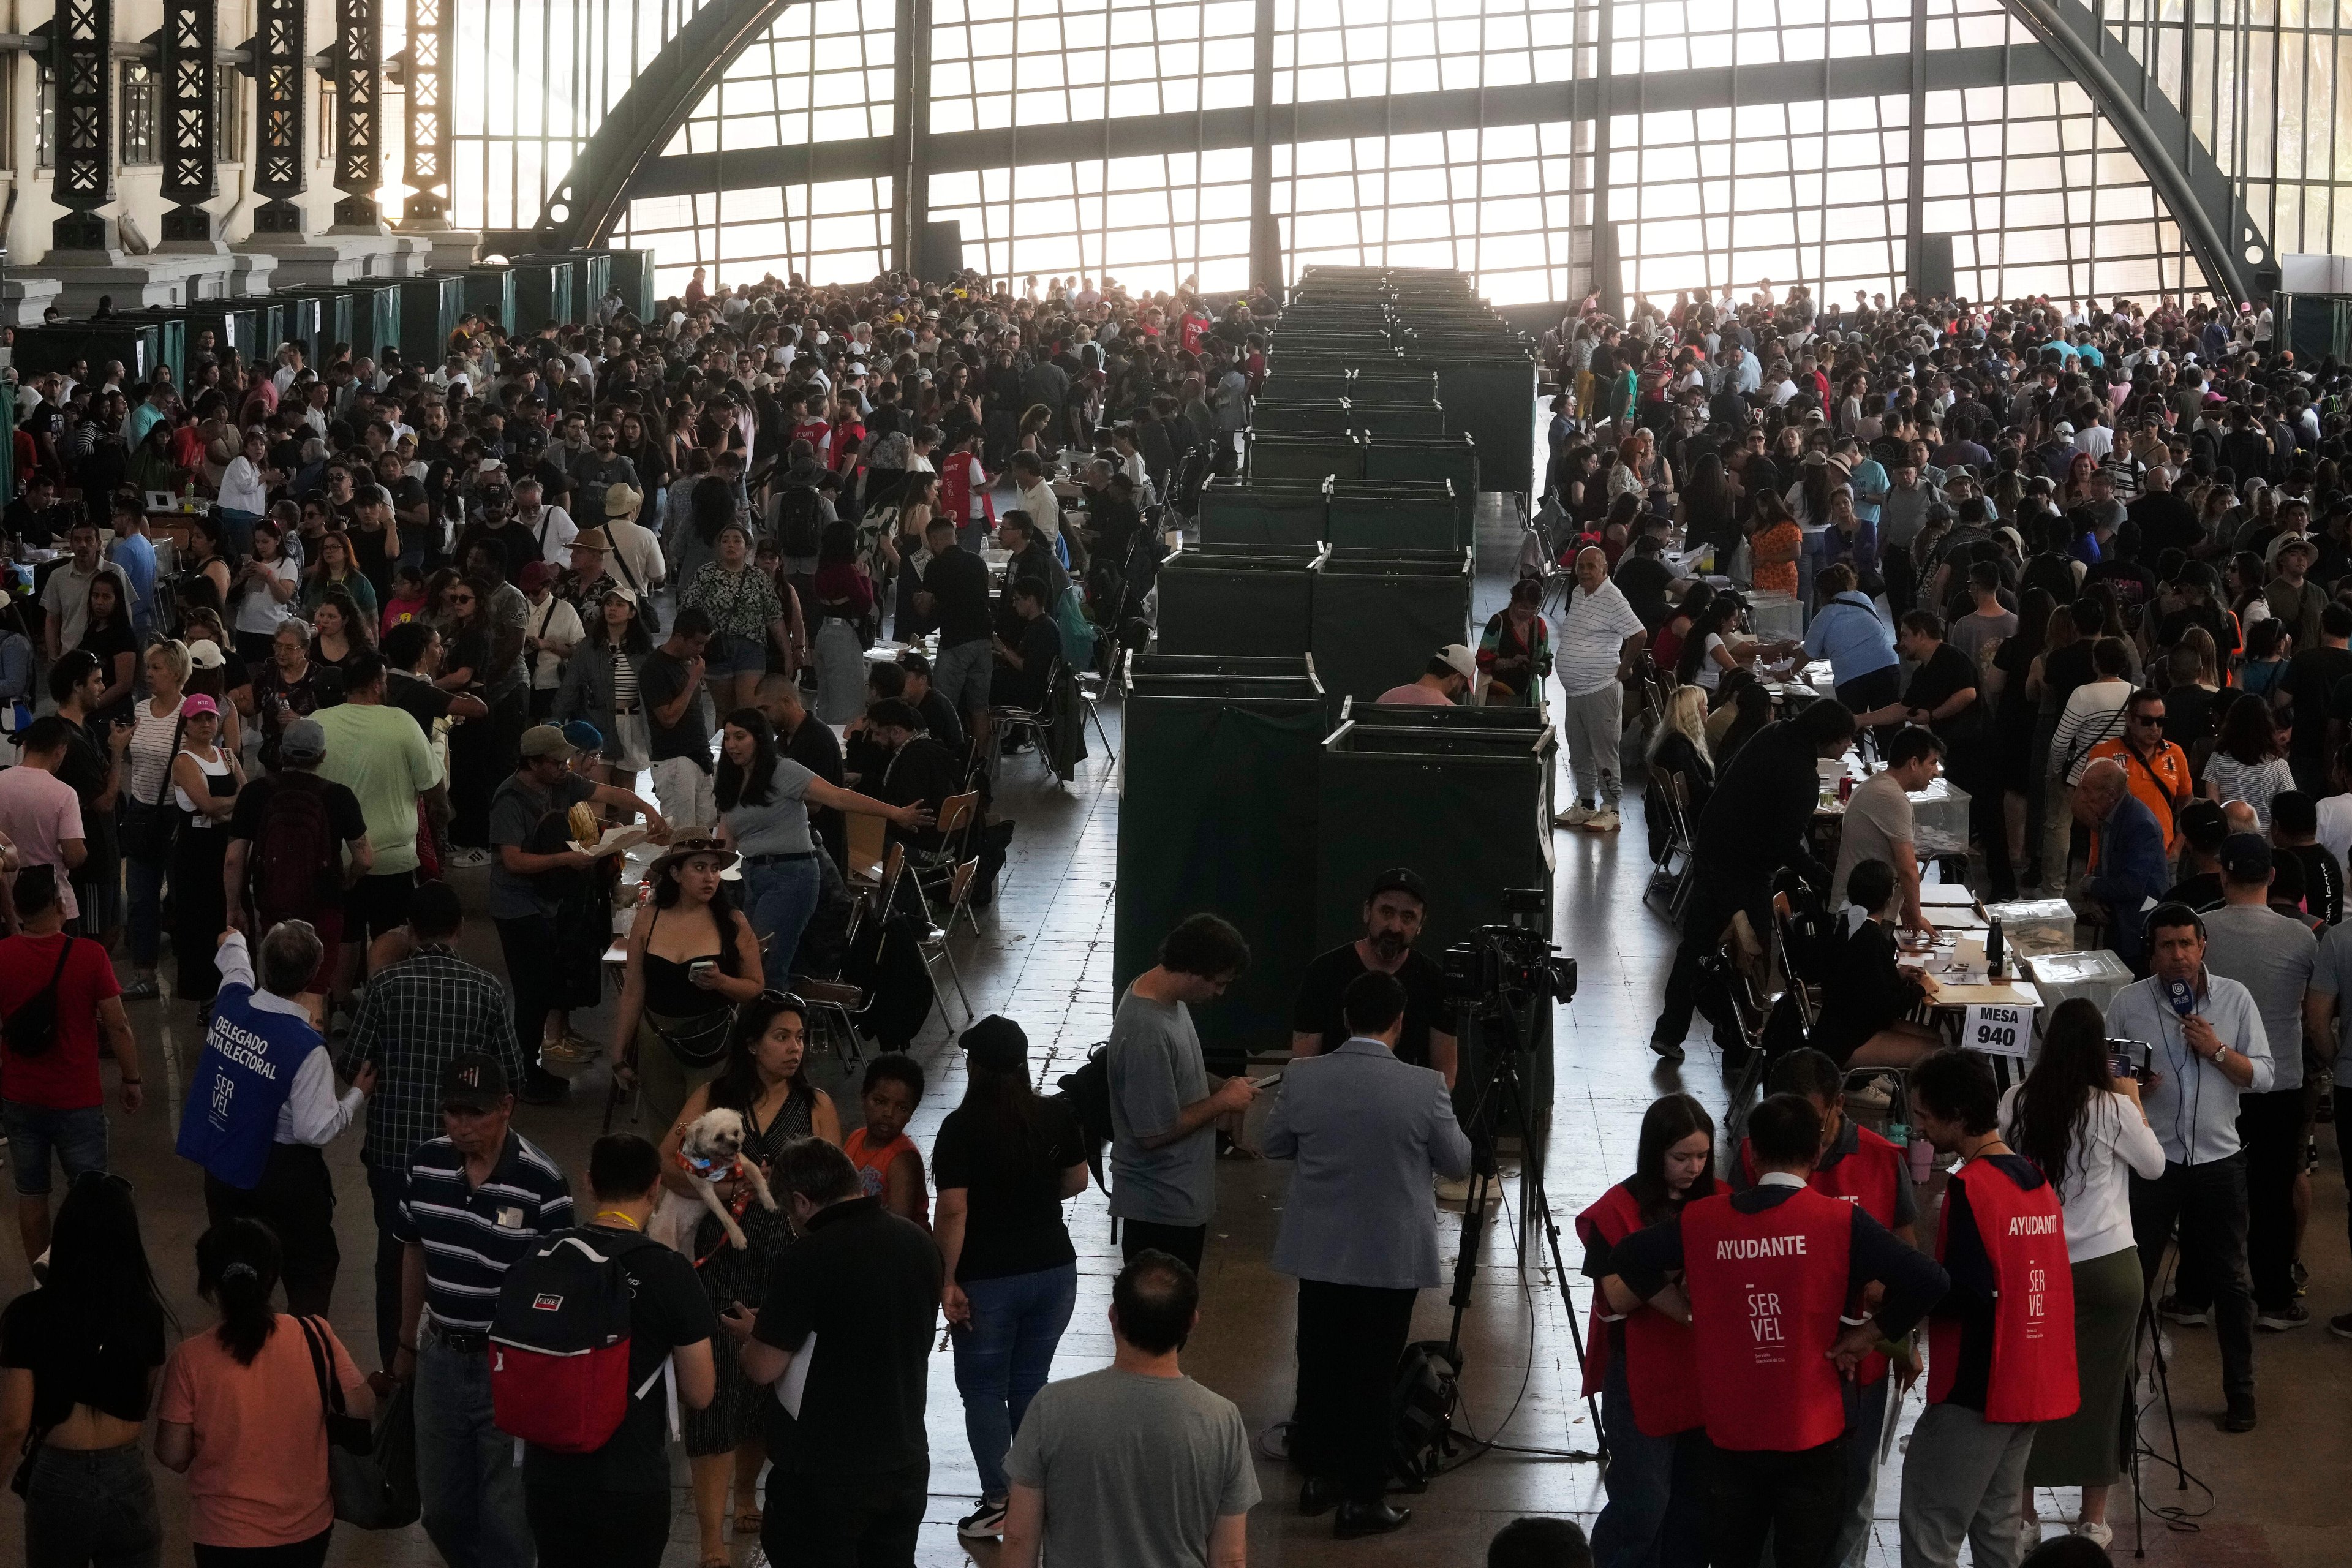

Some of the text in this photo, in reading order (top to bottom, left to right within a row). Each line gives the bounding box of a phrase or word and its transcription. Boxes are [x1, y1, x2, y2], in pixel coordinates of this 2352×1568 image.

[1980, 1006, 2018, 1024] MESA
[215, 1015, 269, 1055] DELEGADO
[1977, 1025, 2016, 1047] 940
[223, 1040, 277, 1080] ELECTORAL
[214, 1073, 235, 1099] SER
[213, 1090, 228, 1117] VEL
[1716, 1235, 1807, 1260] AYUDANTE
[2029, 1268, 2045, 1292] SER
[1747, 1292, 1782, 1317] SER
[2029, 1294, 2045, 1317] VEL
[1750, 1317, 1785, 1342] VEL
